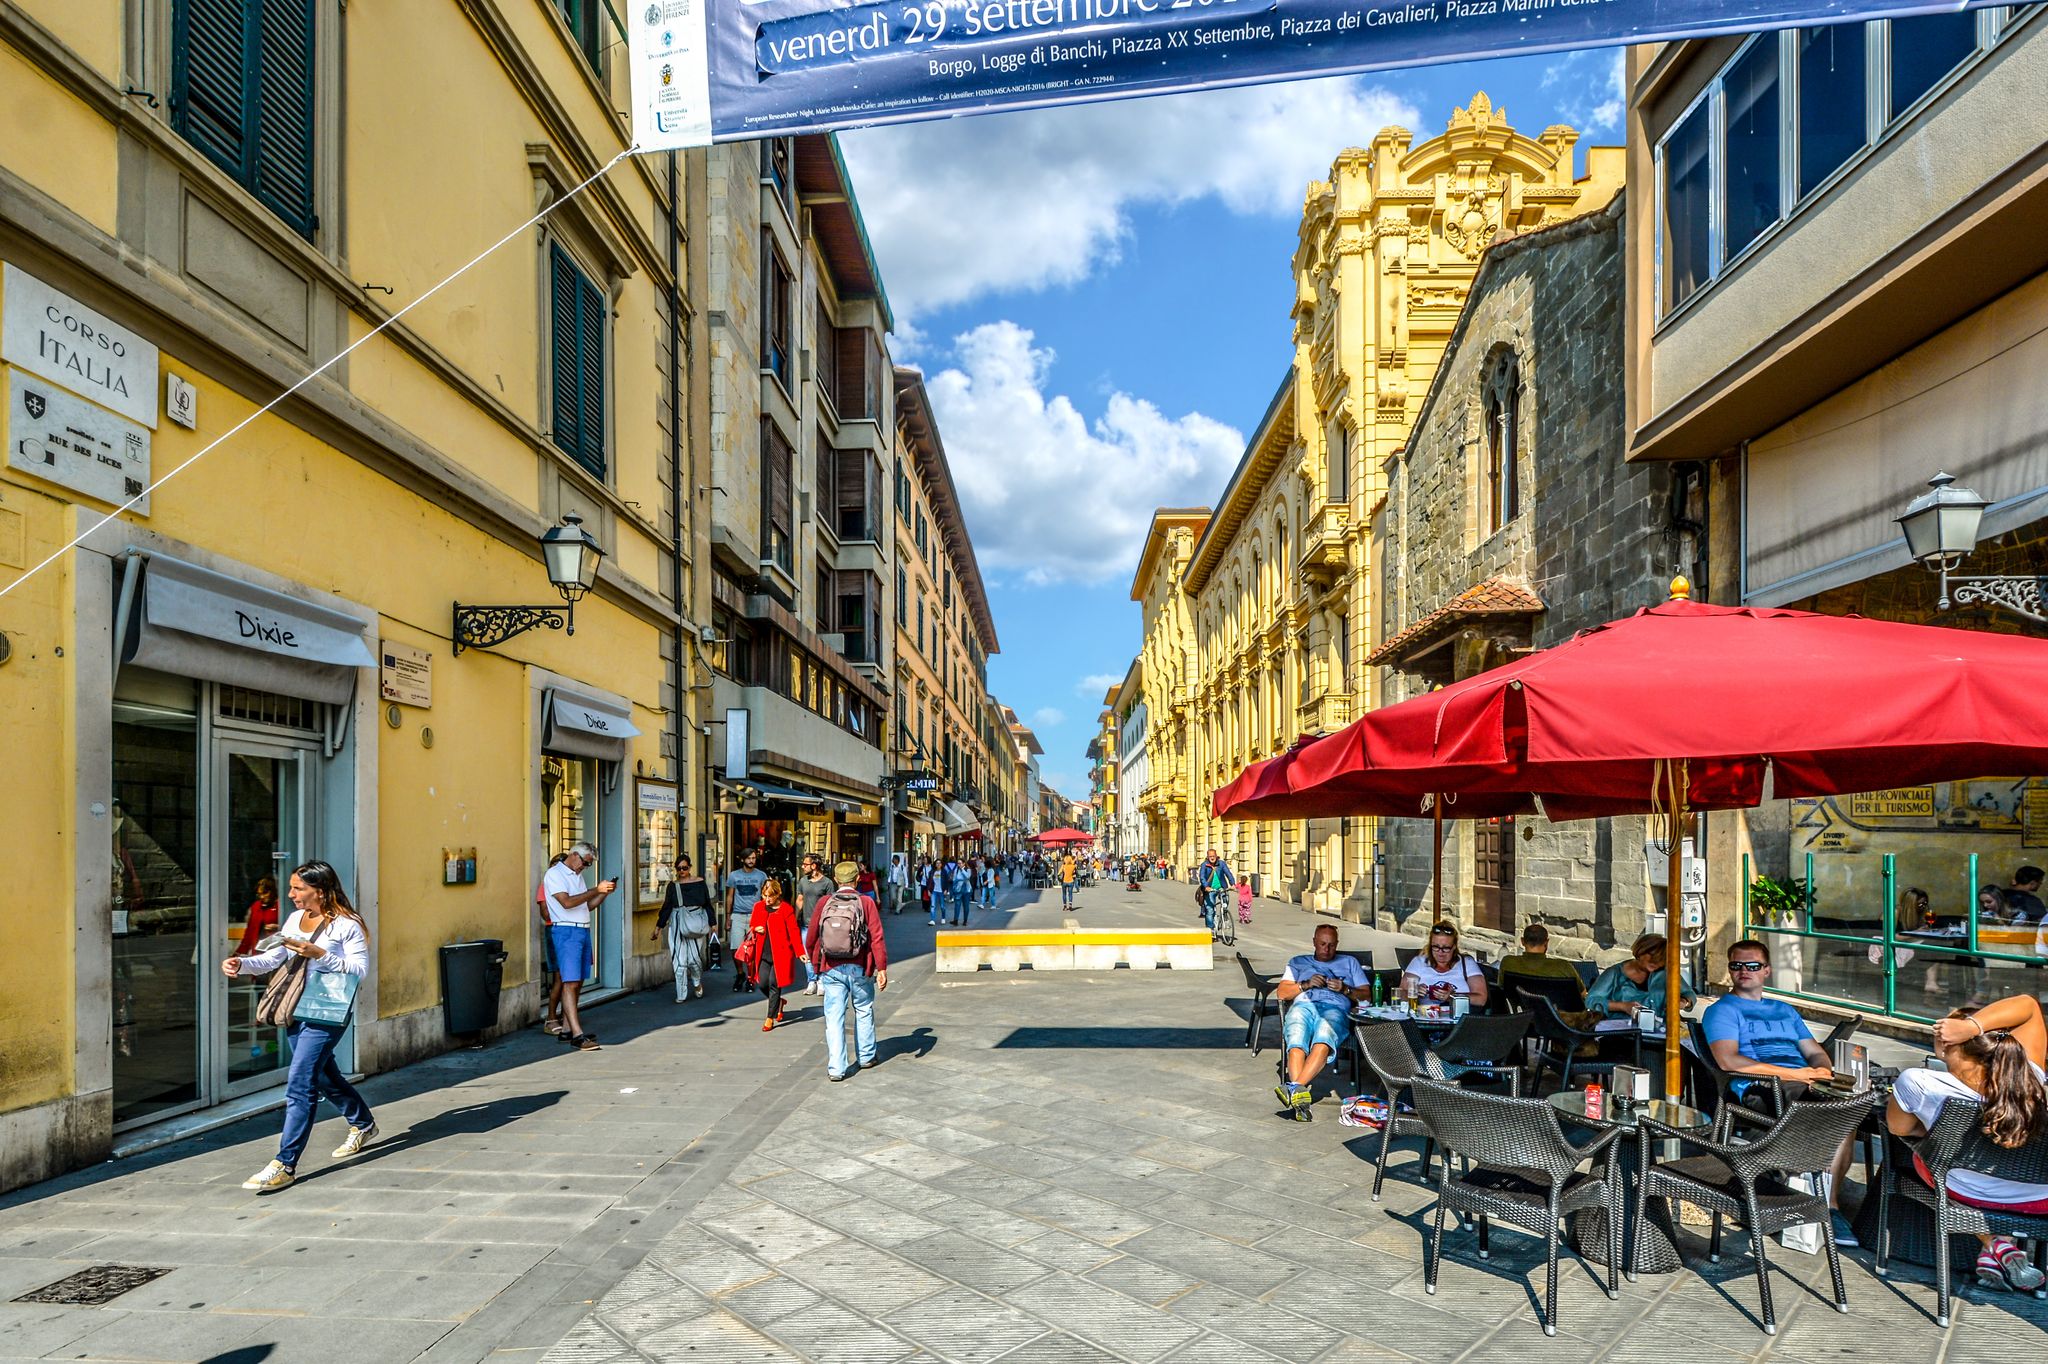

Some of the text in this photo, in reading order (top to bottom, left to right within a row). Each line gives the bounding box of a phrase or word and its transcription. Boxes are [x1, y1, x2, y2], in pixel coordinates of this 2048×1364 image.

[769, 12, 889, 63] venerdì
[903, 4, 947, 45] 29
[929, 58, 976, 78] Borgo,
[982, 51, 1025, 73] Logge
[1031, 47, 1045, 64] di
[1051, 40, 1107, 62] Banchi,
[1112, 36, 1162, 54] Piazza
[1167, 31, 1189, 48] XX
[1193, 22, 1275, 46] Settembre,
[1281, 18, 1331, 35] Piazza
[1336, 12, 1360, 30] dei
[1366, 5, 1439, 27] Cavalieri,
[1446, 1, 1497, 18] Piazza
[745, 115, 768, 123] European
[816, 106, 830, 114] Marie
[918, 95, 934, 103] follow
[939, 92, 949, 100] Call
[1074, 78, 1084, 86] GA
[1084, 76, 1091, 84] N.
[46, 306, 126, 358] CORSO
[40, 329, 129, 399] ITALIA
[49, 433, 122, 470] RUE DES LICES
[234, 610, 299, 648] Dixie
[583, 712, 609, 731] Dixie
[1855, 790, 1931, 801] ENTE PROVINCIALE
[1855, 802, 1931, 813] PER IL TURISMO
